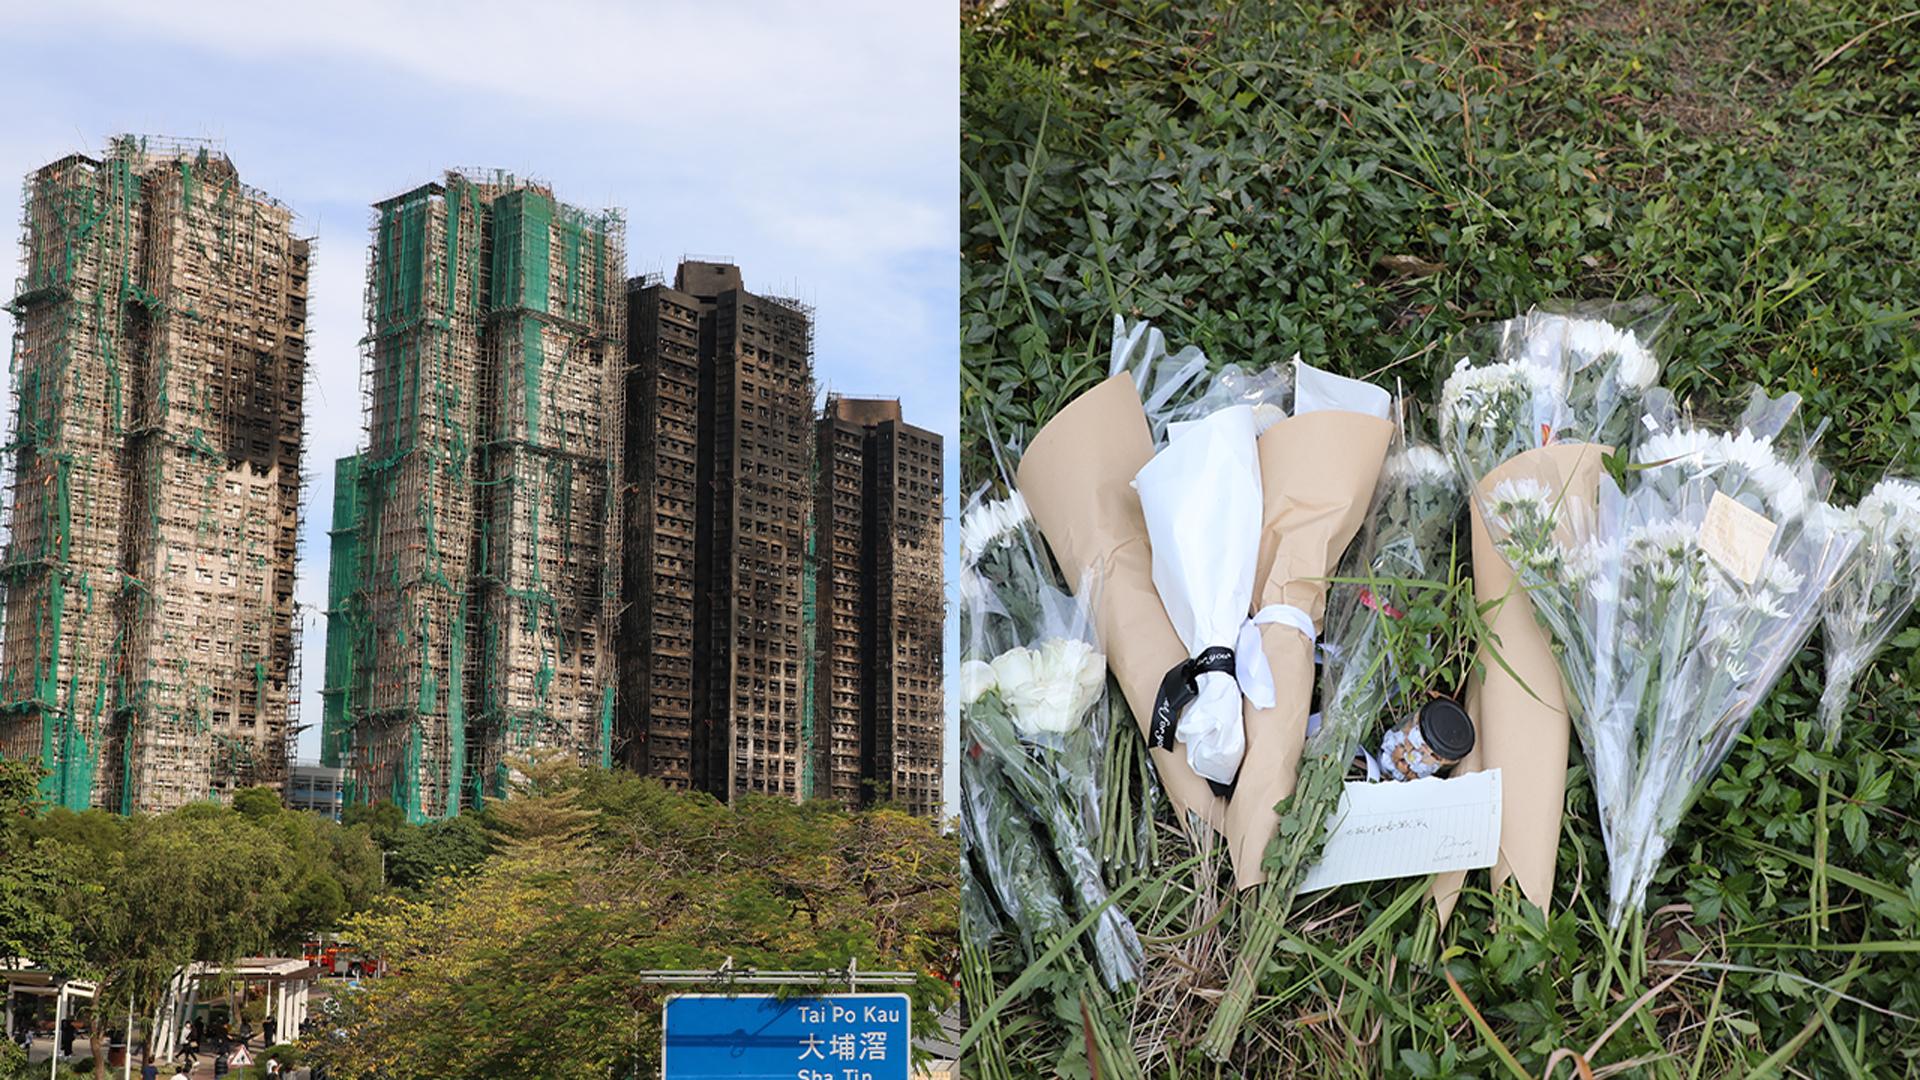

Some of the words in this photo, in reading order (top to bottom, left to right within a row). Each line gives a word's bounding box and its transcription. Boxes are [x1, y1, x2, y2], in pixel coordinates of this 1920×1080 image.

[798, 1006, 825, 1023] Tai
[832, 1006, 856, 1023] Po
[864, 1006, 900, 1023] Kau
[798, 1031, 887, 1061] 大埔滘
